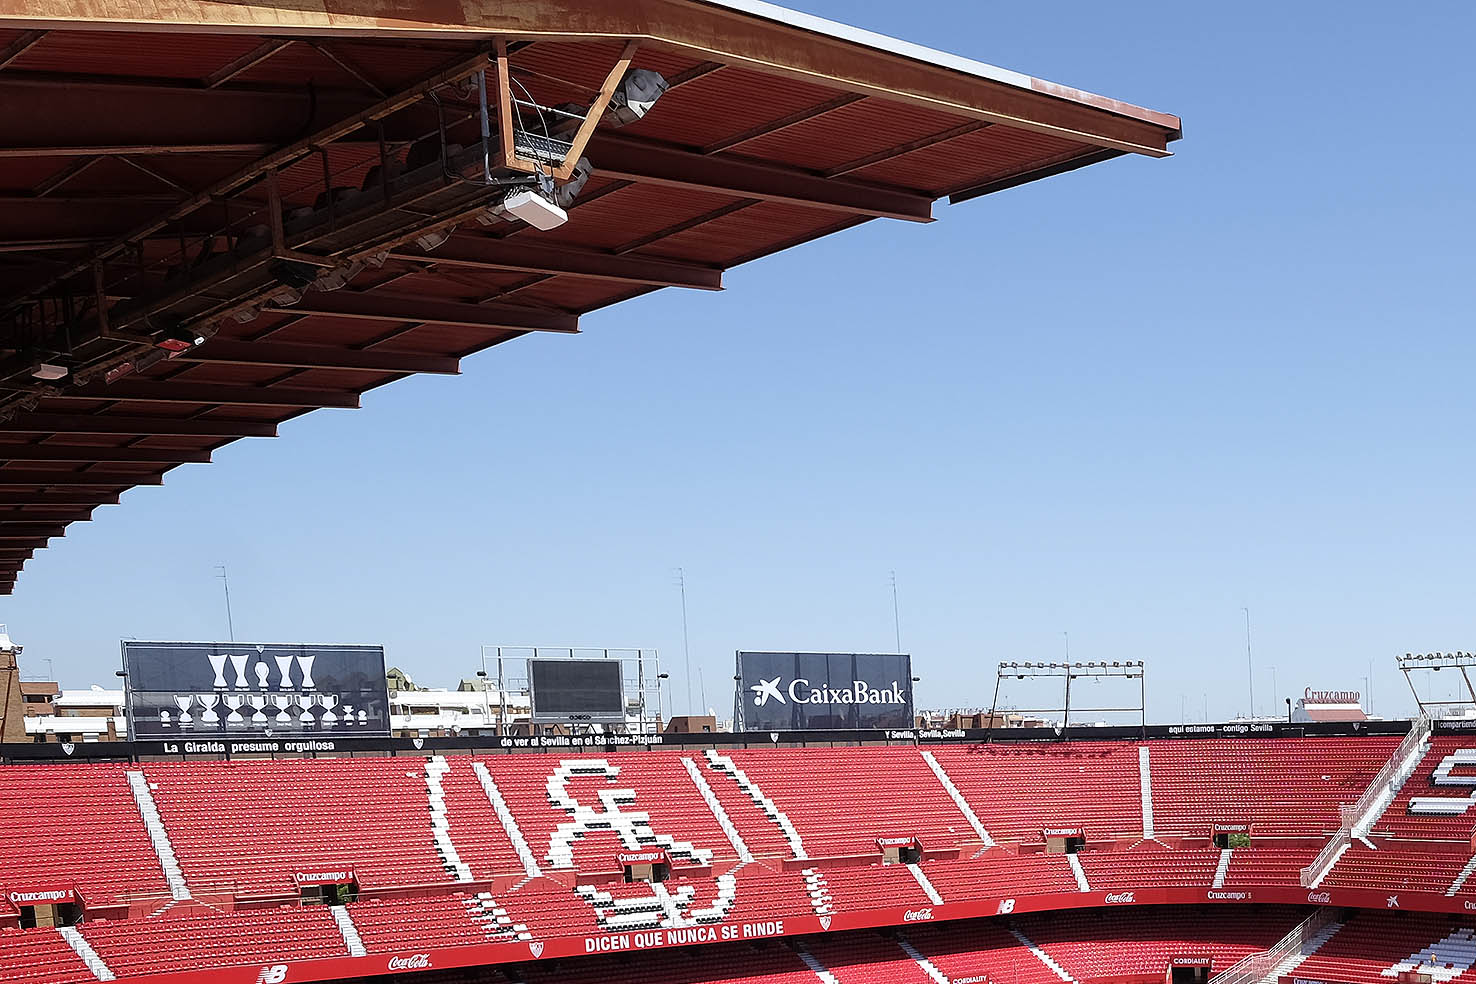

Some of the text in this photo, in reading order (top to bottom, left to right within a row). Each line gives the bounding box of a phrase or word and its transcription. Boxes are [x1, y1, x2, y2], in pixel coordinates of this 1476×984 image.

[788, 679, 906, 705] CaixaBank
[1304, 686, 1360, 701] Cruzcampo
[163, 740, 335, 754] La Giralda presume orgullosa
[514, 738, 529, 747] ver
[296, 870, 346, 882] Cruzcampo
[10, 888, 66, 904] Cruzcampo
[1207, 891, 1246, 901] Cruzcampo
[584, 920, 785, 953] DICEN QUE NUNCA SE RINDE
[1173, 957, 1210, 965] CORDIALITY
